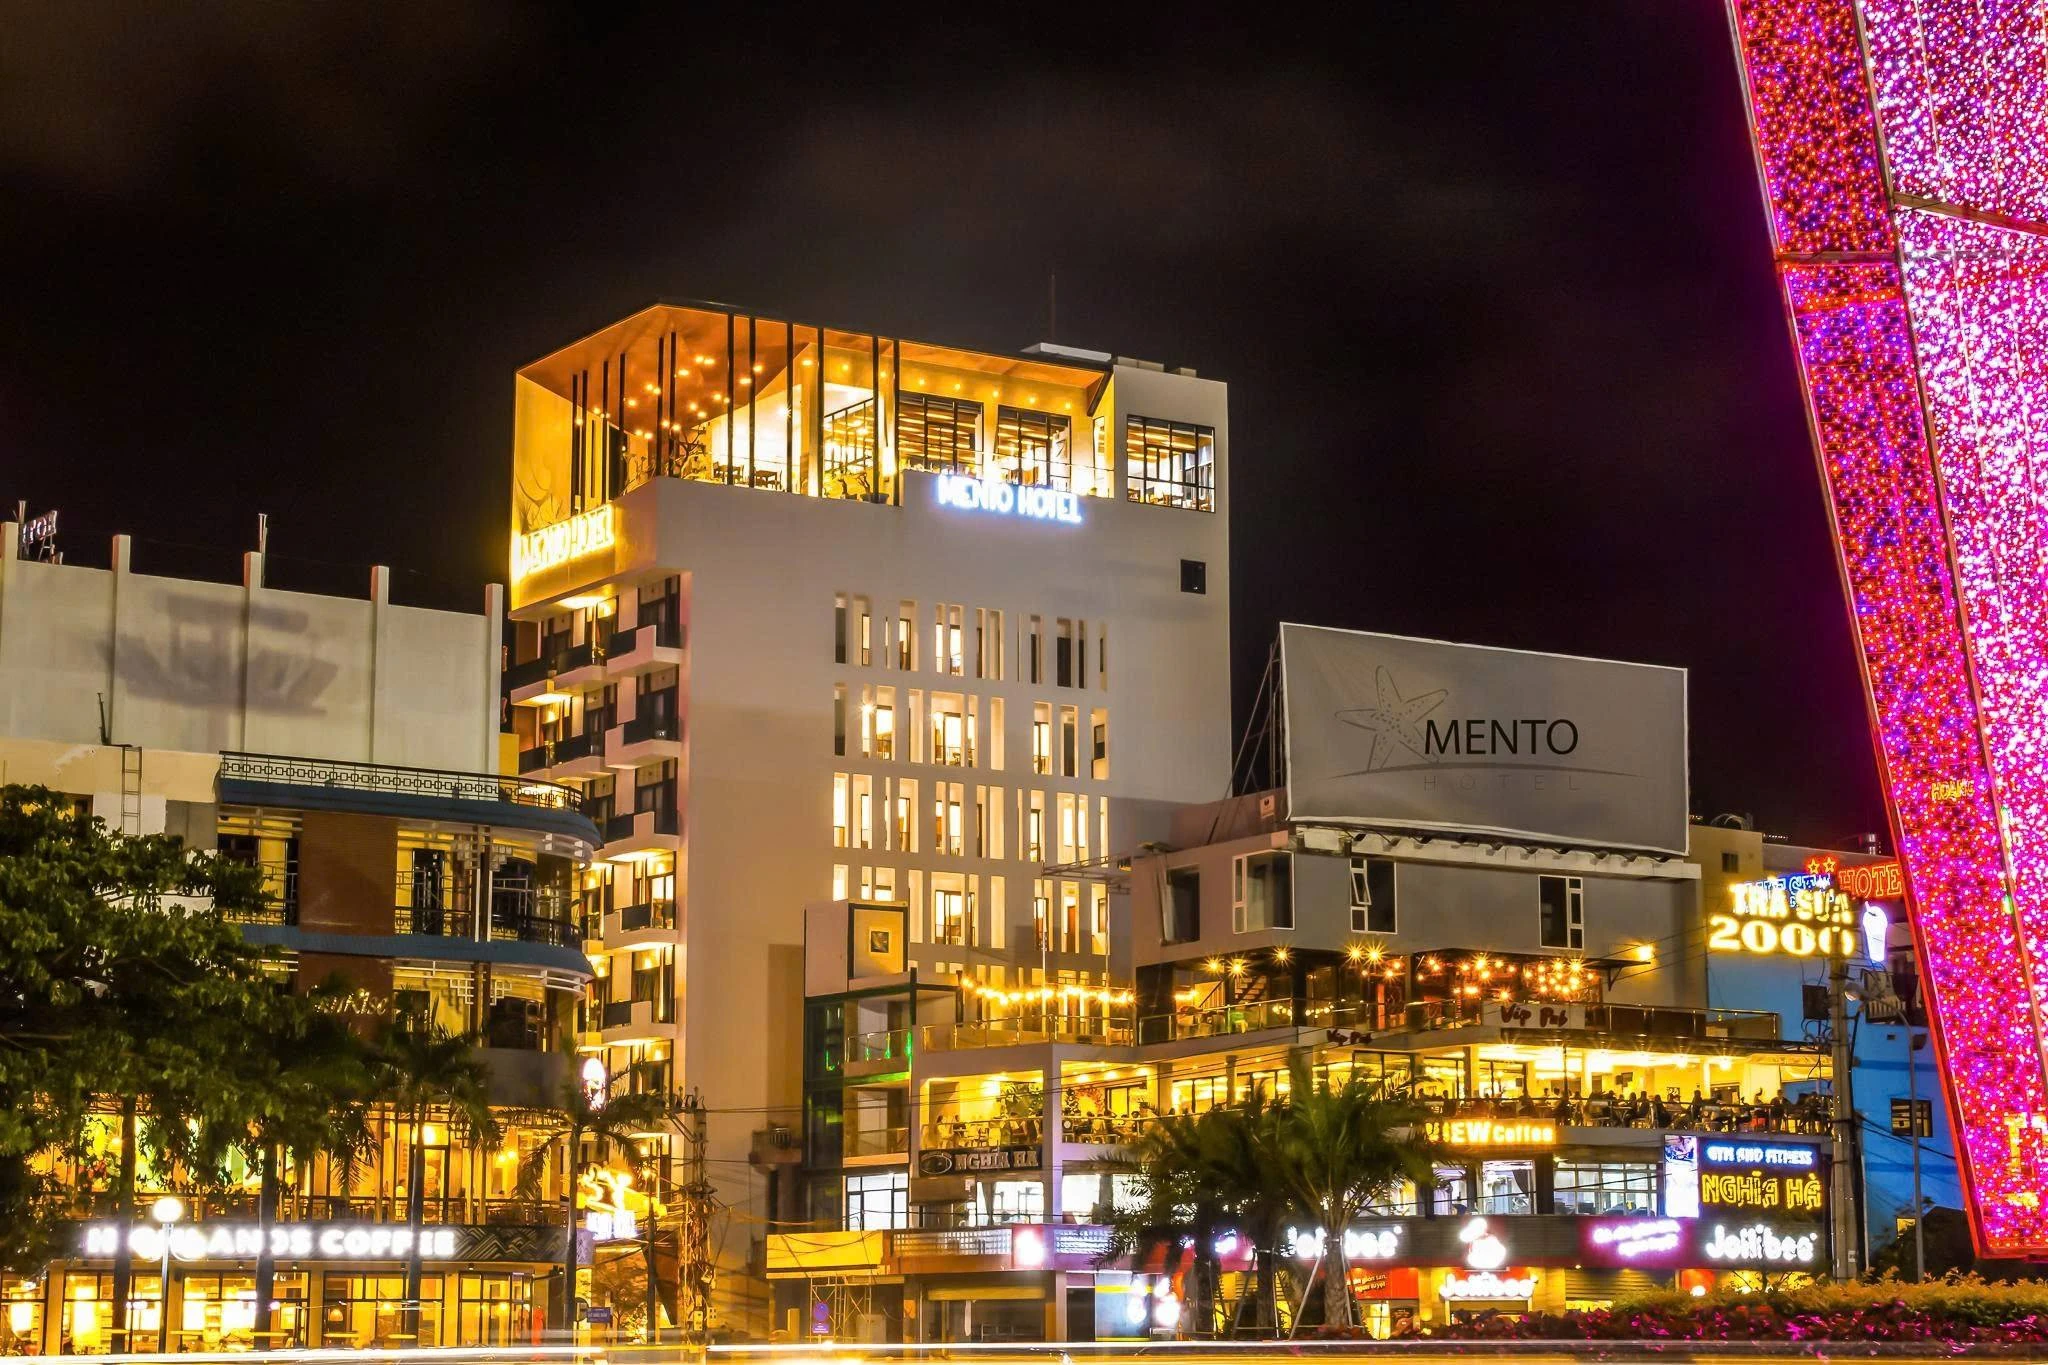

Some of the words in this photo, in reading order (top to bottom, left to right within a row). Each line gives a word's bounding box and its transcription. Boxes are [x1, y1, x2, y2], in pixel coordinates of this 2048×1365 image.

[938, 473, 1014, 513] MENTO
[1017, 485, 1082, 523] HOTEL
[1424, 719, 1578, 755] MENTO
[1424, 774, 1581, 792] HOTEL
[1786, 1173, 1822, 1210] HÀ
[1706, 1224, 1814, 1261] Jollibee
